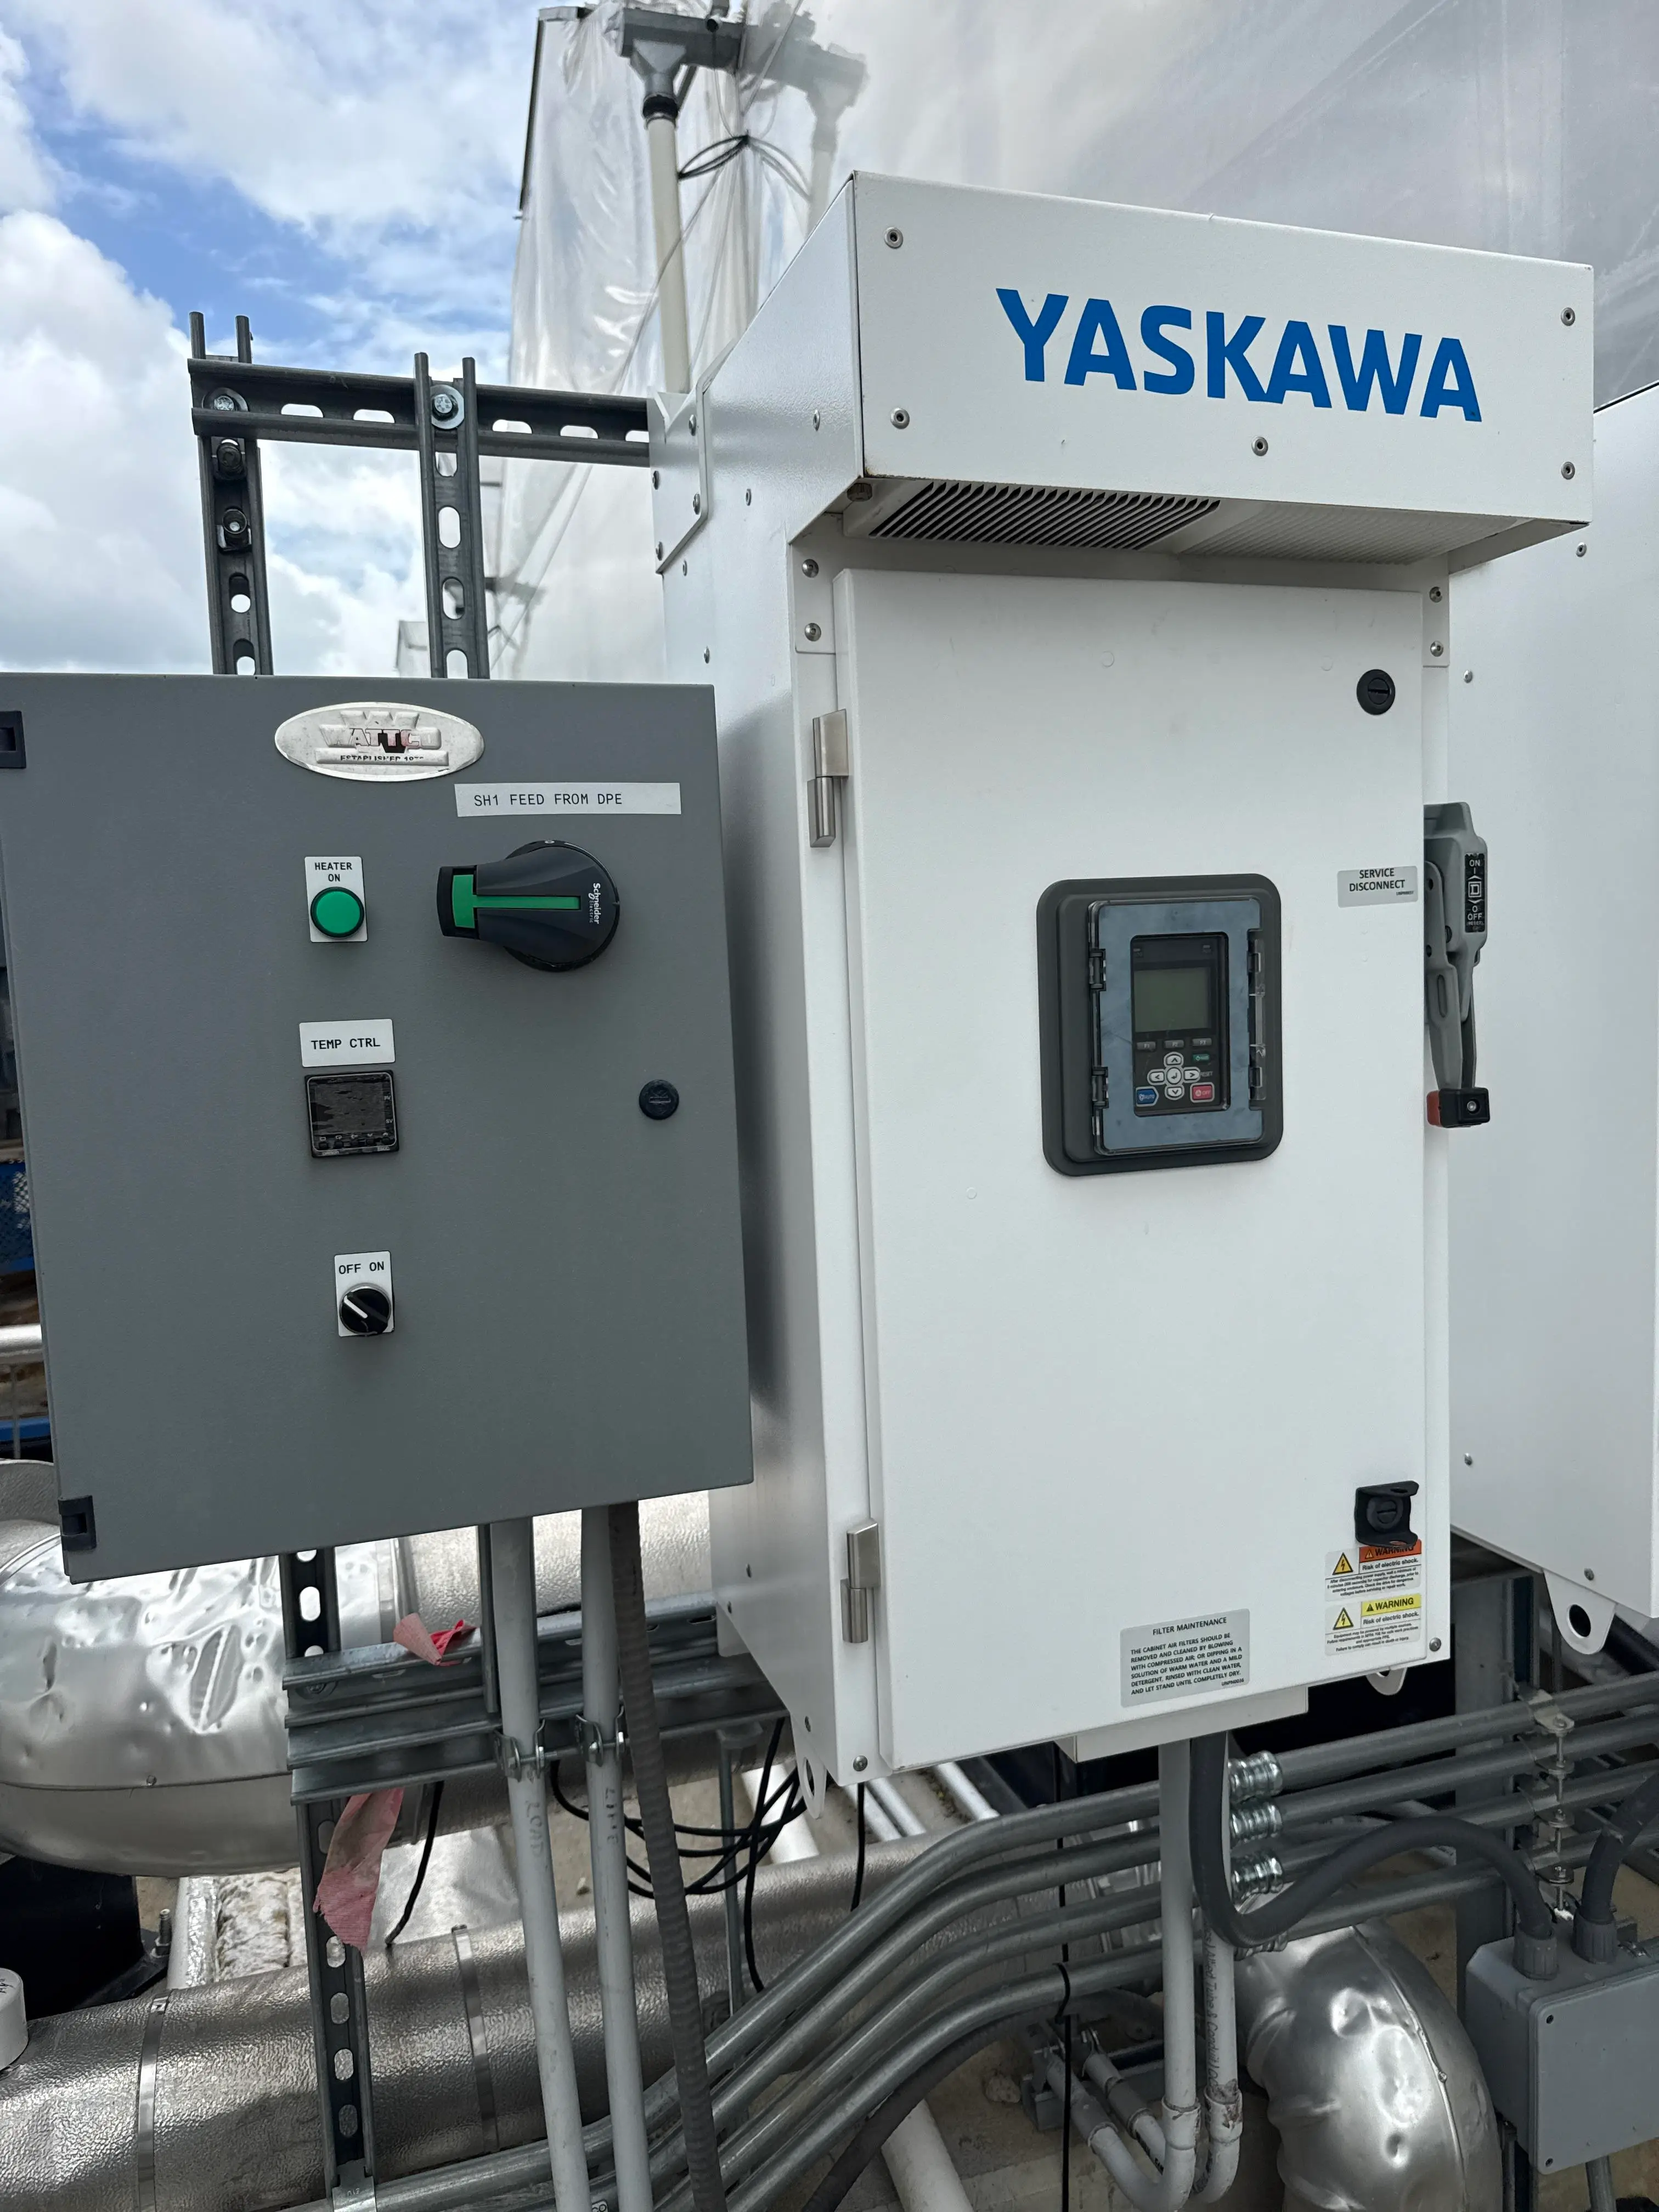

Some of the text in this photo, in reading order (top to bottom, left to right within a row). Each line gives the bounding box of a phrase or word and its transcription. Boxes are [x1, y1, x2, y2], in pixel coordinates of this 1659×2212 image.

[996, 288, 1482, 422] YASKAWA
[474, 793, 622, 806] SH1 FEED FROM DPE
[315, 862, 352, 870] HEATER
[1359, 868, 1395, 878] SERVICE
[1350, 879, 1405, 891] DISCONNECT
[593, 883, 601, 924] Schneider
[311, 1038, 381, 1049] TEMP CTRL
[338, 1261, 385, 1274] OFF ON
[1375, 1597, 1414, 1610] WARNING
[1153, 1617, 1227, 1635] FILTER MAINTENANCE
[1143, 1644, 1166, 1652] CABINET
[1200, 1634, 1222, 1643] SHOULD
[1131, 1654, 1158, 1663] REMOVED
[1173, 1646, 1198, 1655] CLEANED
[1208, 1640, 1233, 1649] BLOWING
[1147, 1657, 1183, 1668] COMPRESSED
[1207, 1649, 1229, 1657] DIPPING
[1131, 1669, 1158, 1679] SOLUTION
[1156, 1682, 1175, 1690] STAND
[1193, 1672, 1227, 1683] COMPLETELY
